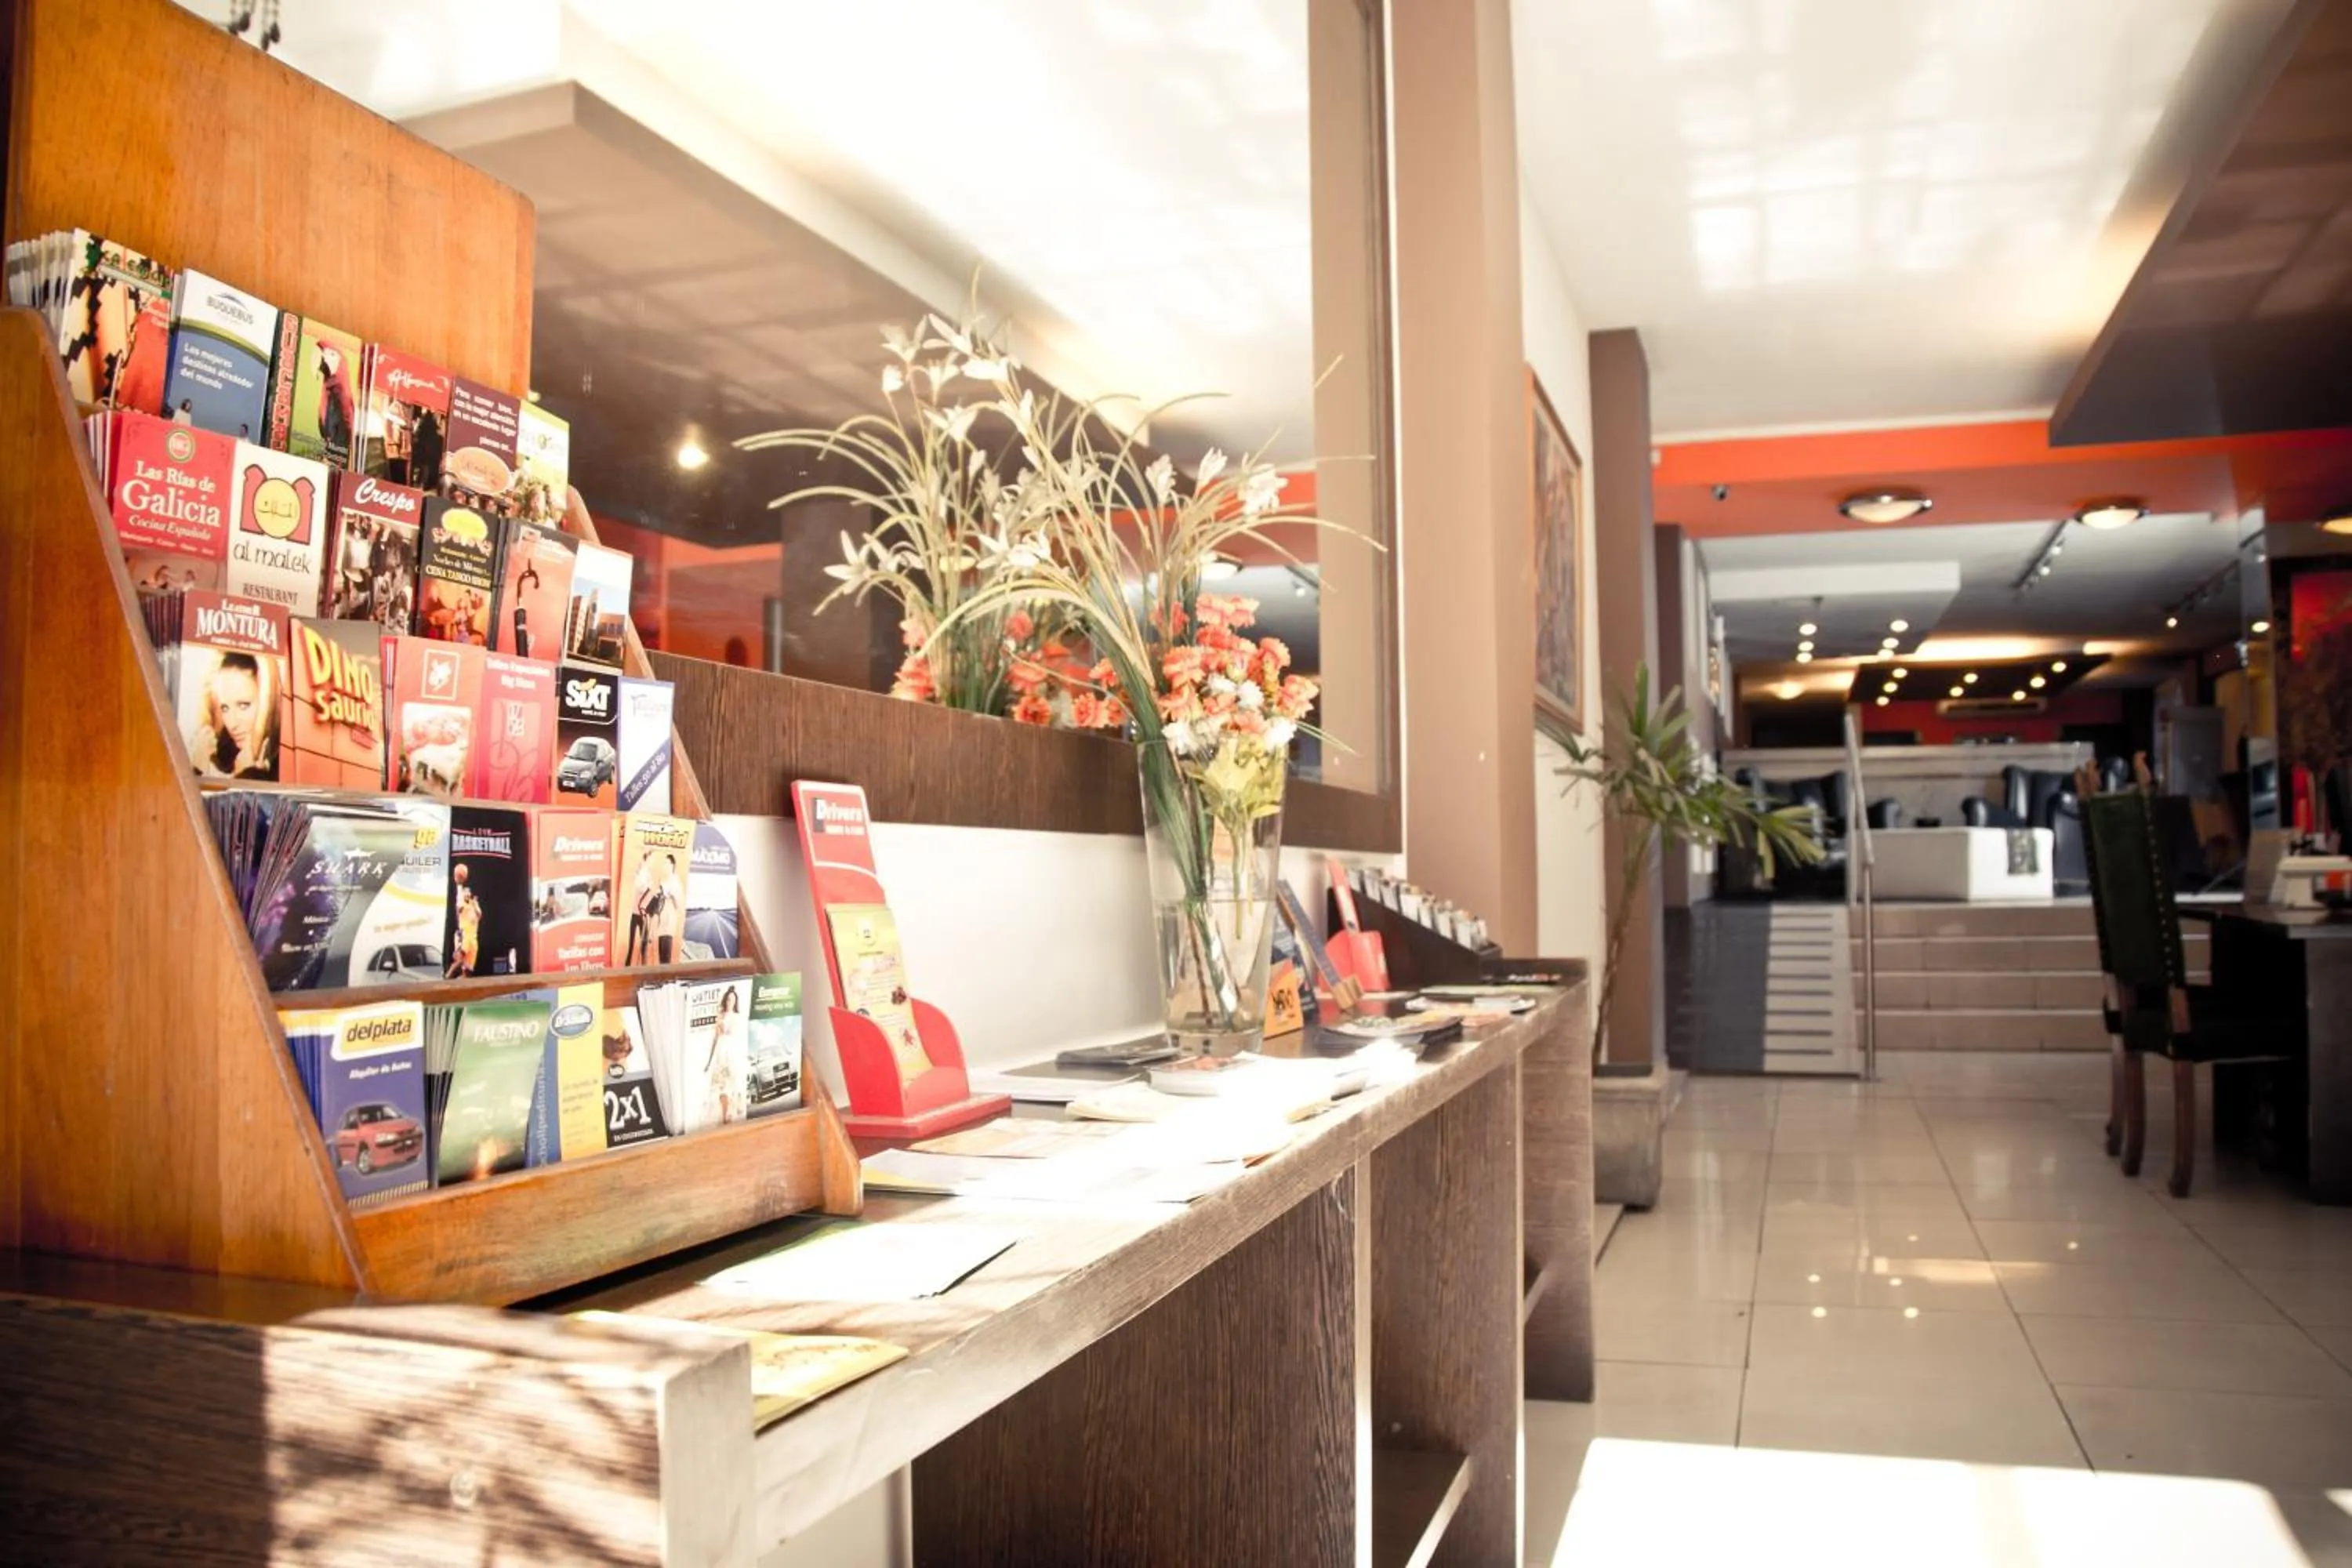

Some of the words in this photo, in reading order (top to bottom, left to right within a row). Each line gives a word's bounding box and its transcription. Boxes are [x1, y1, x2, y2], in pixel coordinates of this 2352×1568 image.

[136, 460, 162, 481] Las
[198, 476, 216, 492] de
[122, 479, 221, 528] Galicia
[354, 477, 415, 512] Crespo
[234, 543, 251, 563] al
[254, 549, 311, 575] malek
[242, 583, 298, 605] RESTAURANT
[196, 608, 278, 651] MONTURA
[303, 626, 373, 704] DINO
[815, 798, 864, 822] Drivers
[451, 833, 512, 855] BASKETBALL
[305, 861, 387, 879] SHARK
[347, 1018, 412, 1044] delplata
[474, 1022, 539, 1043] FAUSTINO
[604, 1085, 652, 1131] 2x1
